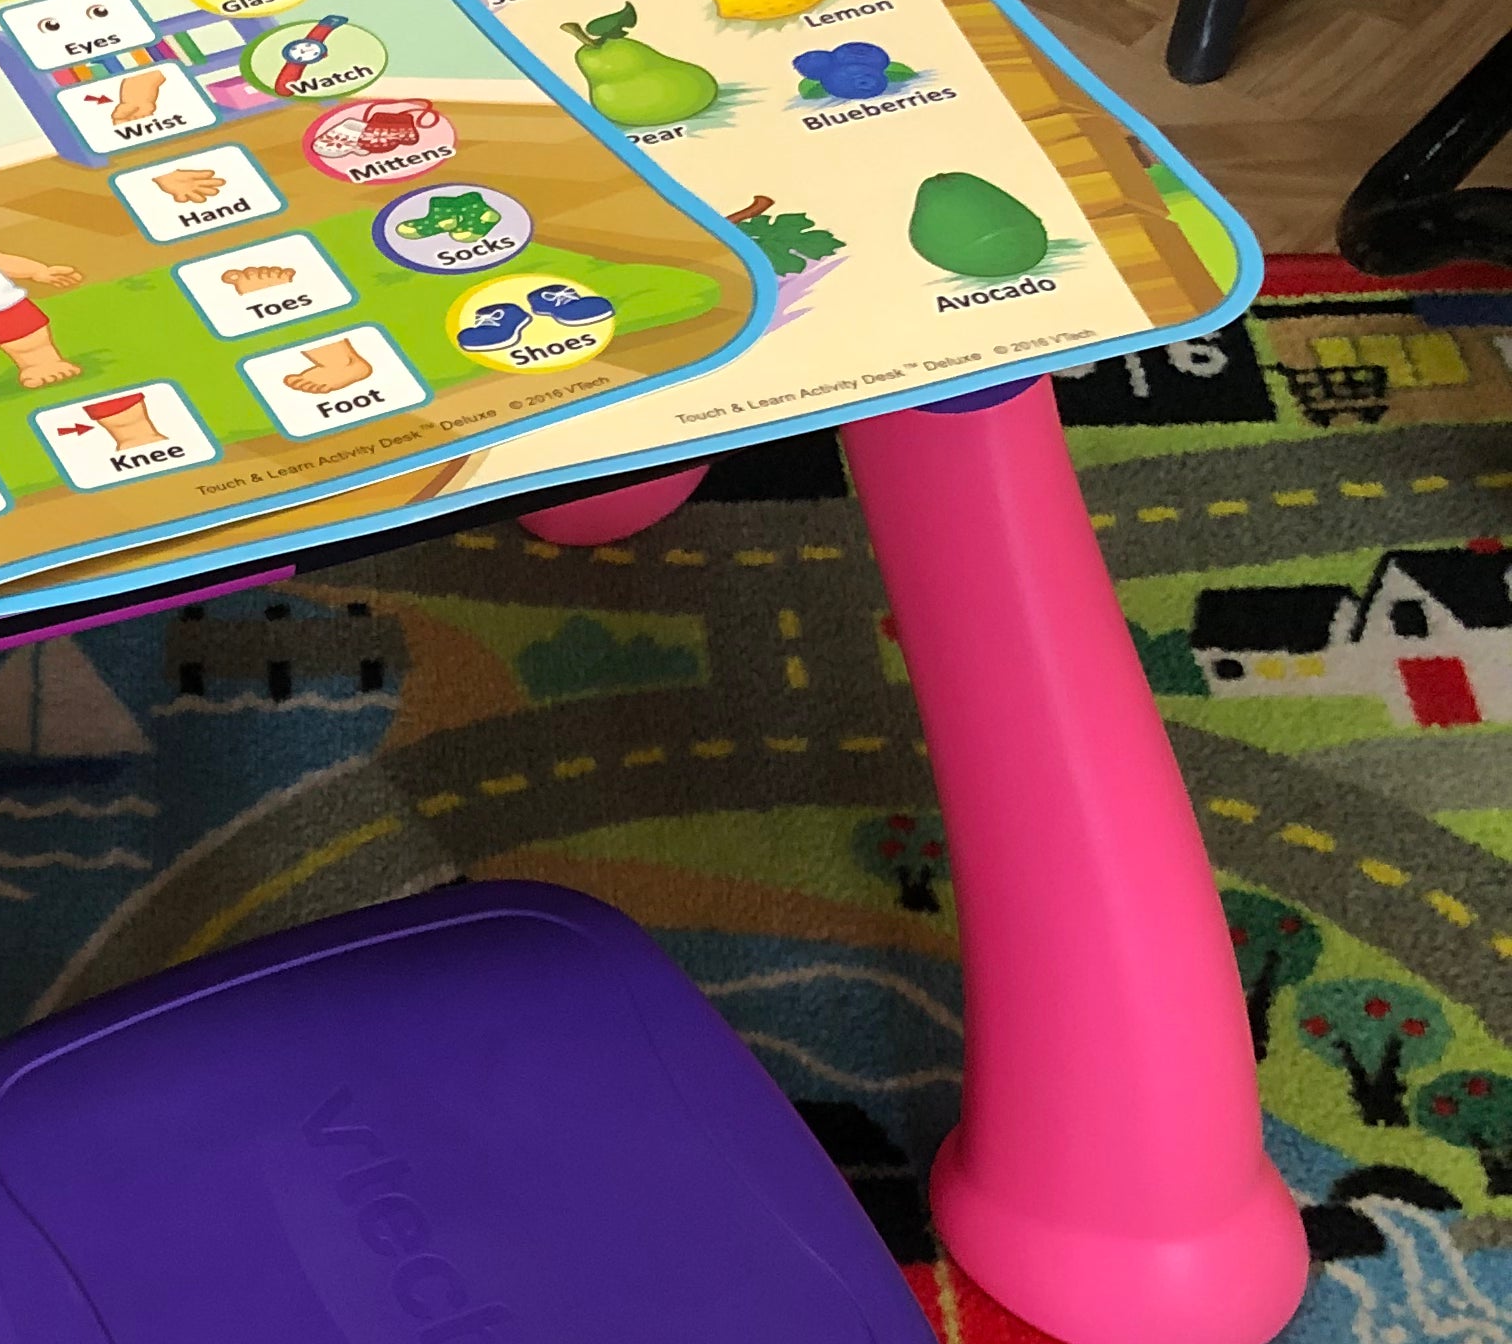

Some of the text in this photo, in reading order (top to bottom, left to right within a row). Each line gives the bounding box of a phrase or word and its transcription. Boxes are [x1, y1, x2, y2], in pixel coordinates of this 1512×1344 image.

[804, 0, 894, 29] Lemon
[64, 33, 121, 57] Eyes
[289, 64, 373, 94] Watch
[802, 86, 958, 132] Blueberries
[115, 113, 188, 141] Wrist
[349, 142, 453, 183] Mittens
[178, 197, 251, 229] Hand
[437, 234, 516, 266] Socks
[245, 292, 313, 320] Toes
[936, 276, 1057, 313] Avocado
[510, 331, 597, 366] Shoes
[676, 406, 724, 426] Touch
[731, 403, 744, 414] &
[746, 392, 798, 411] Learn
[800, 377, 858, 400] Activity
[923, 350, 982, 372] Deluxe
[1050, 329, 1097, 344] VTech
[316, 387, 384, 420] Foot
[197, 475, 246, 496] Touch
[251, 469, 263, 484] &
[267, 461, 315, 481] Learn
[318, 442, 376, 468] Activity
[439, 407, 497, 432] Deluxe
[564, 376, 609, 394] VTech
[110, 443, 186, 472] Knee
